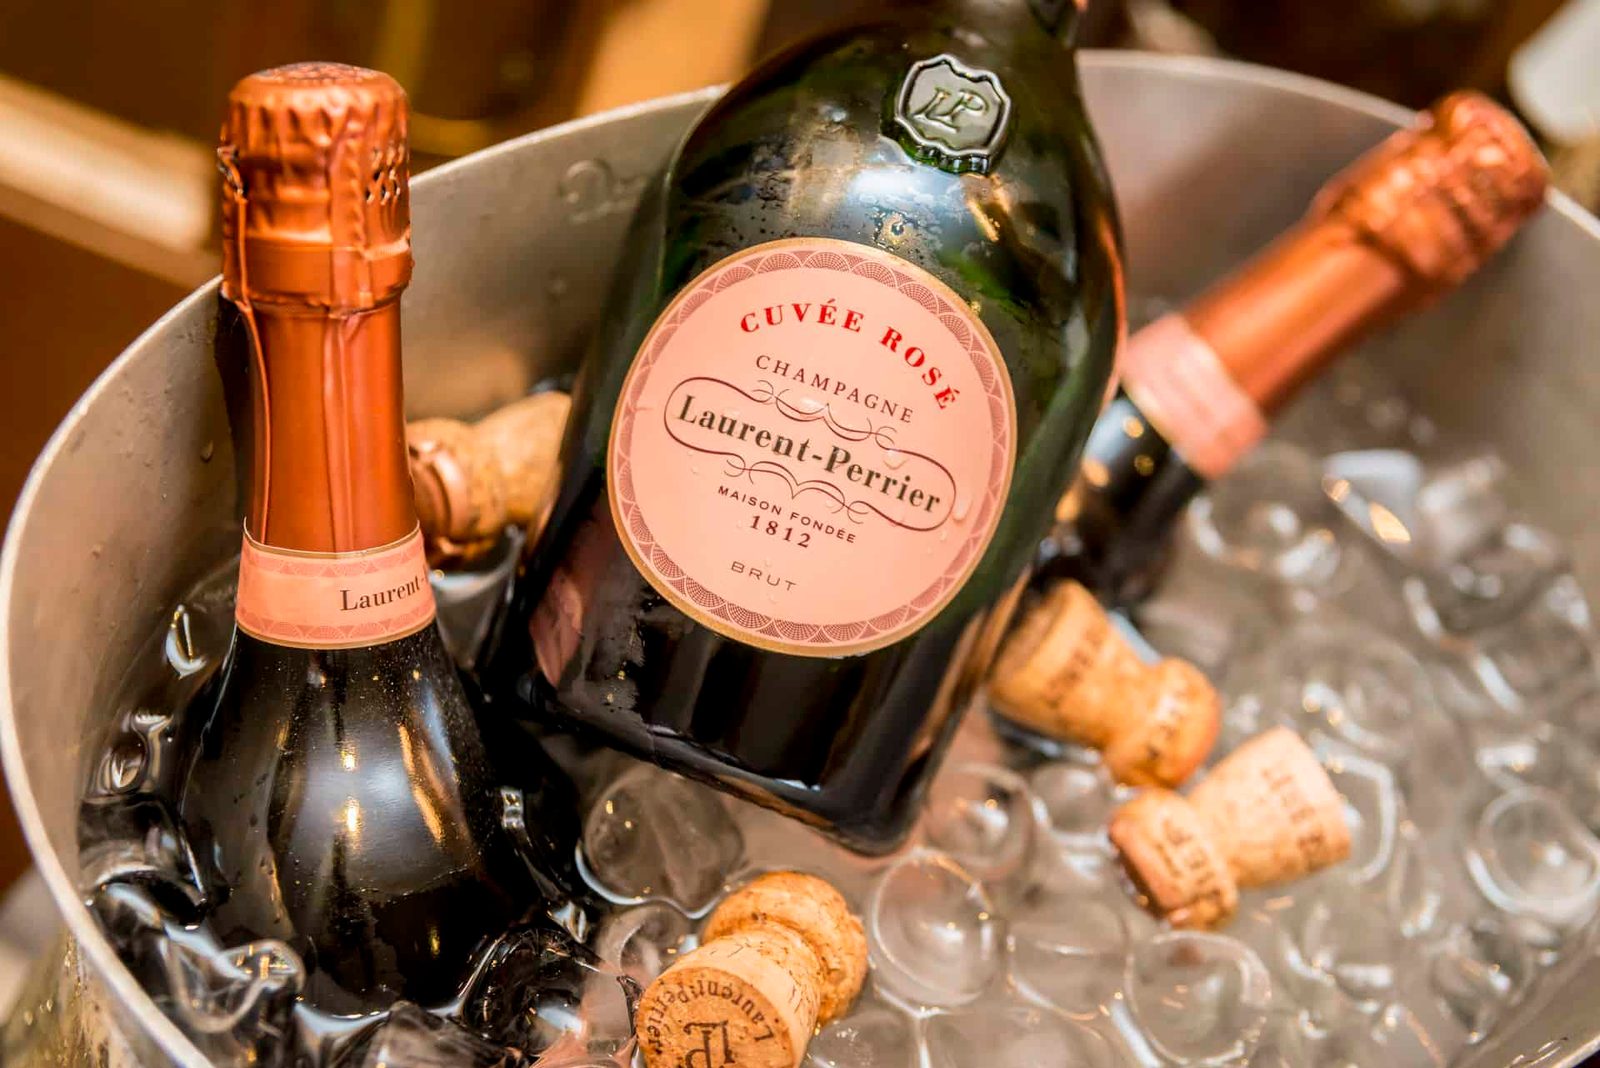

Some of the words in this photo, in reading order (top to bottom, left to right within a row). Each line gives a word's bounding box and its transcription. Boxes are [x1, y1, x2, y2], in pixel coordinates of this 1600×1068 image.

[912, 86, 990, 134] LP
[740, 299, 864, 332] CUVÉE
[879, 326, 960, 410] ROSÉ
[756, 354, 914, 423] CHAMPAGNE
[677, 394, 941, 514] Laurent-Perrier
[718, 485, 782, 515] MAISON
[750, 515, 811, 548] 1812
[731, 561, 797, 592] BRUT
